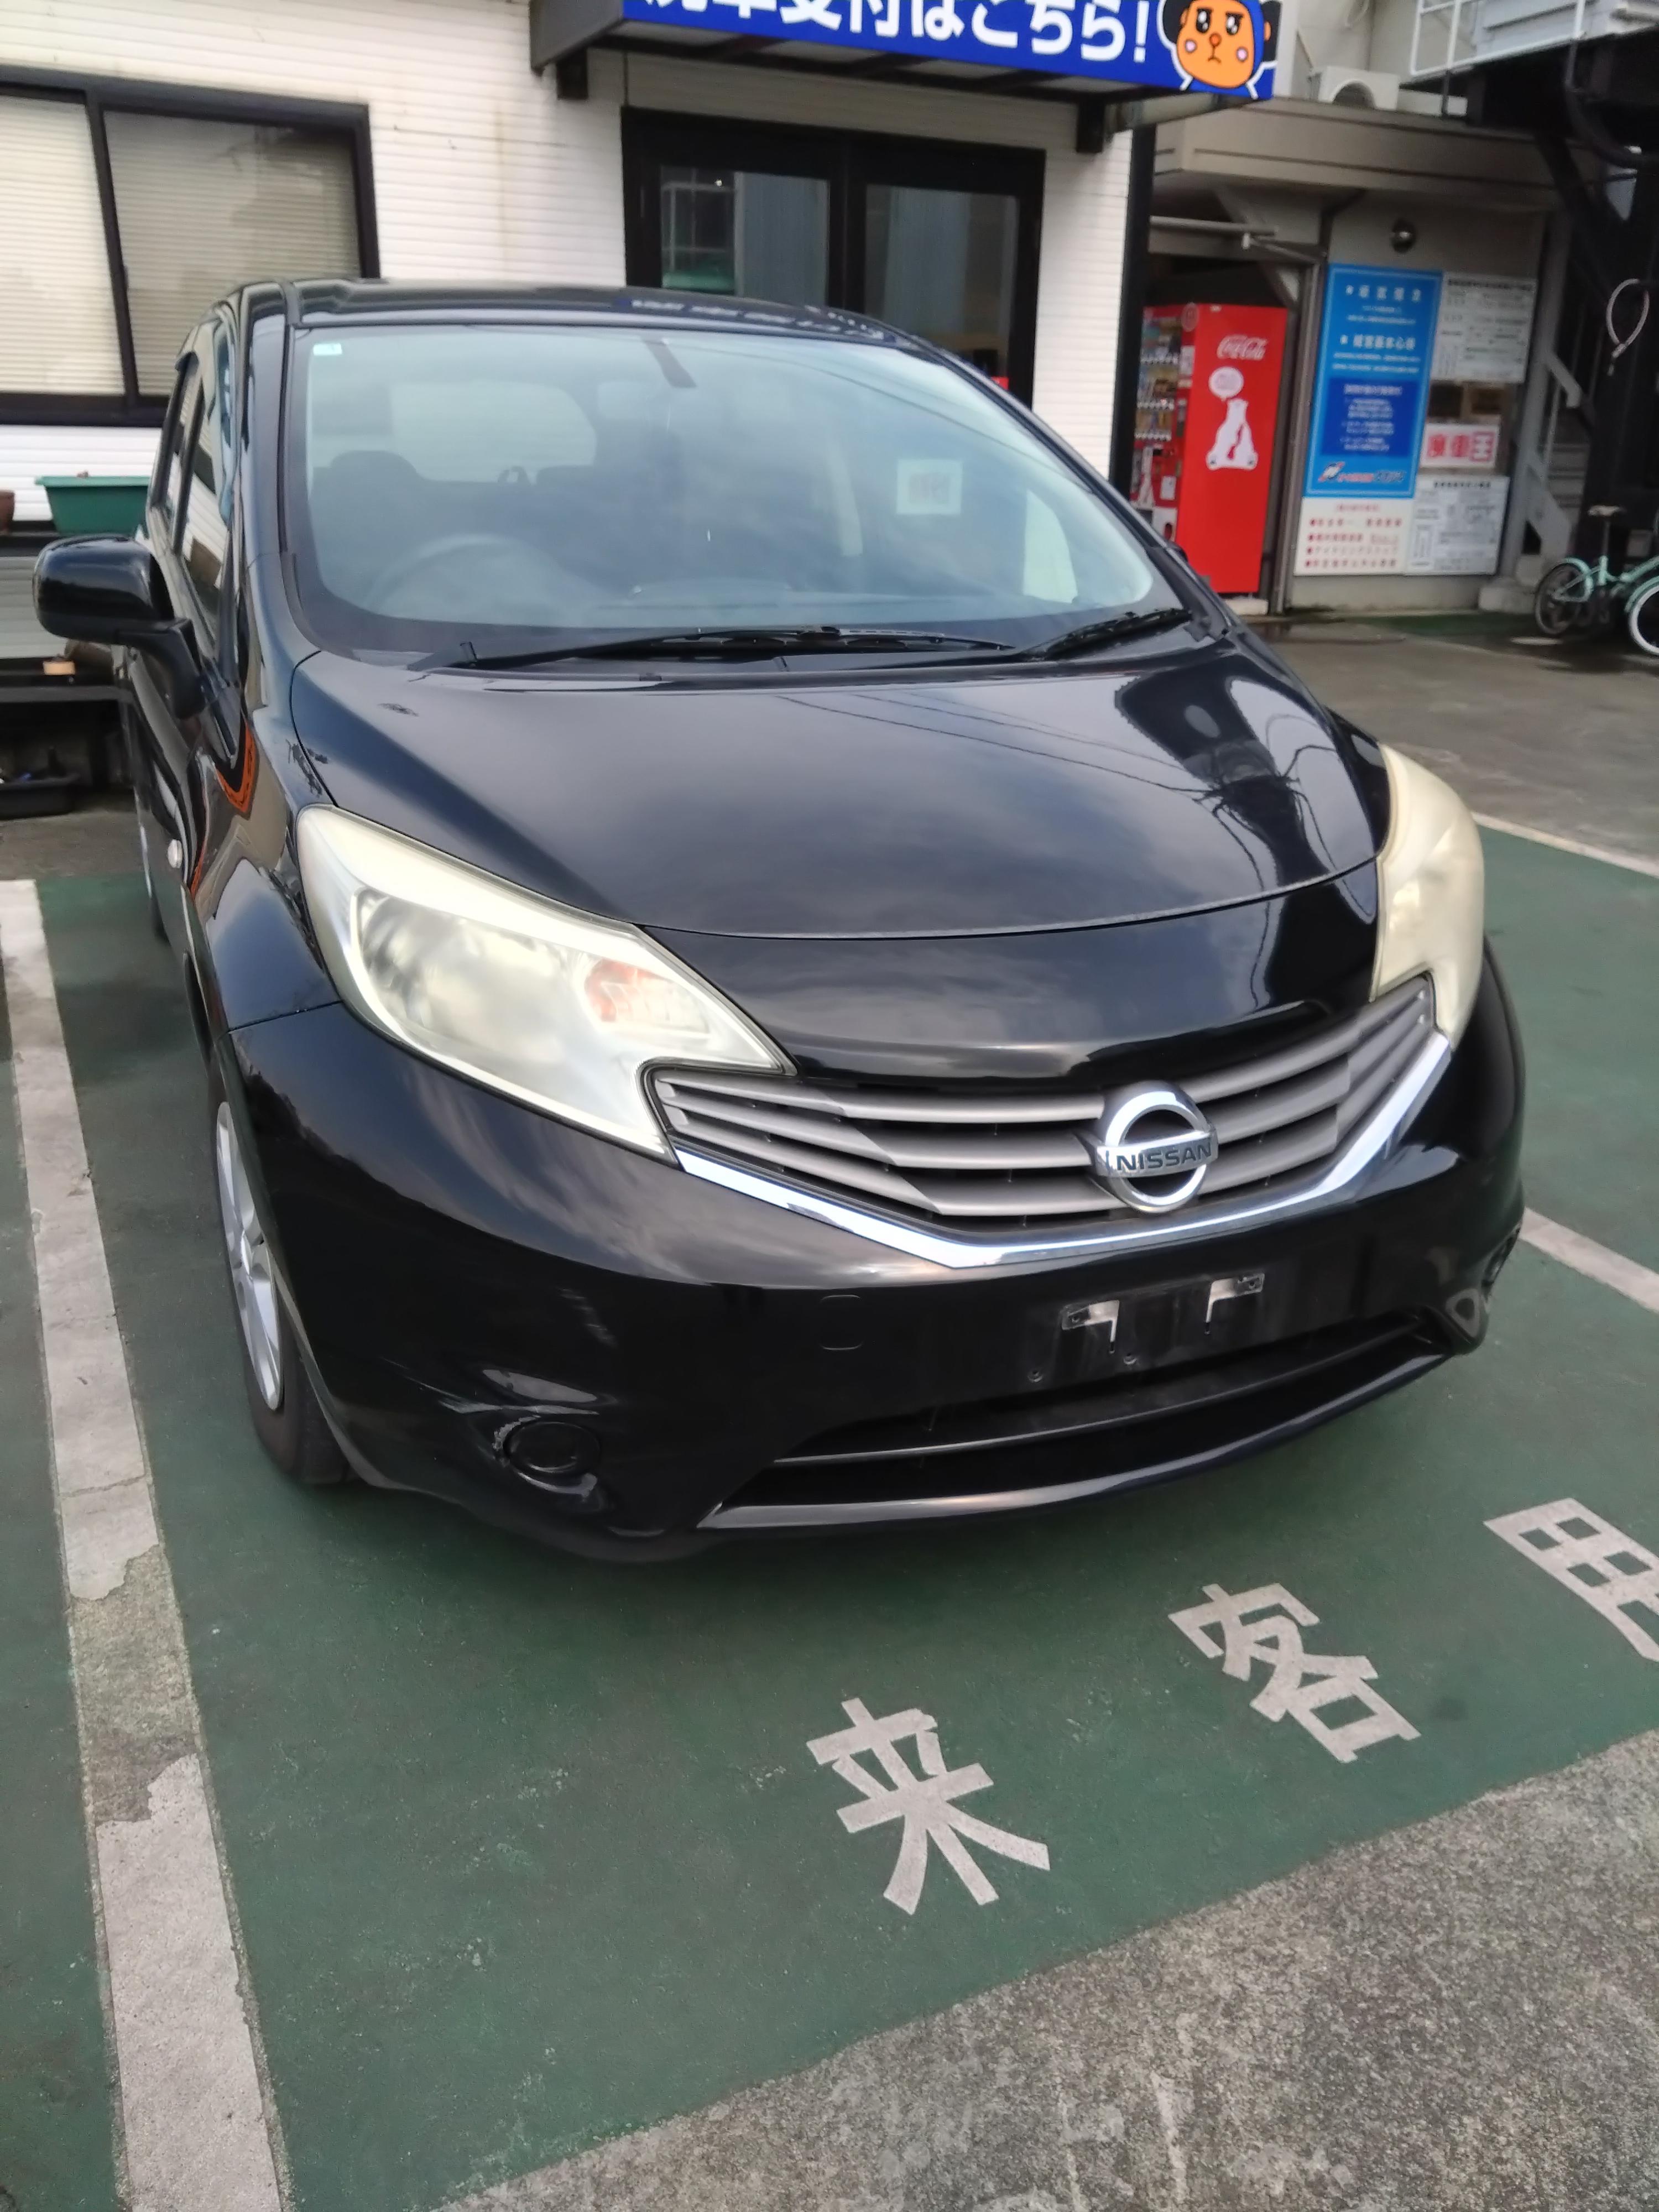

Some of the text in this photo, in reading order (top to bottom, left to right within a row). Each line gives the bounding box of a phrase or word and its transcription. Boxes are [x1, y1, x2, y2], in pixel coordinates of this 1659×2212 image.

[643, 0, 1149, 63] 付はこちら!
[1117, 1142, 1212, 1172] NISSAN
